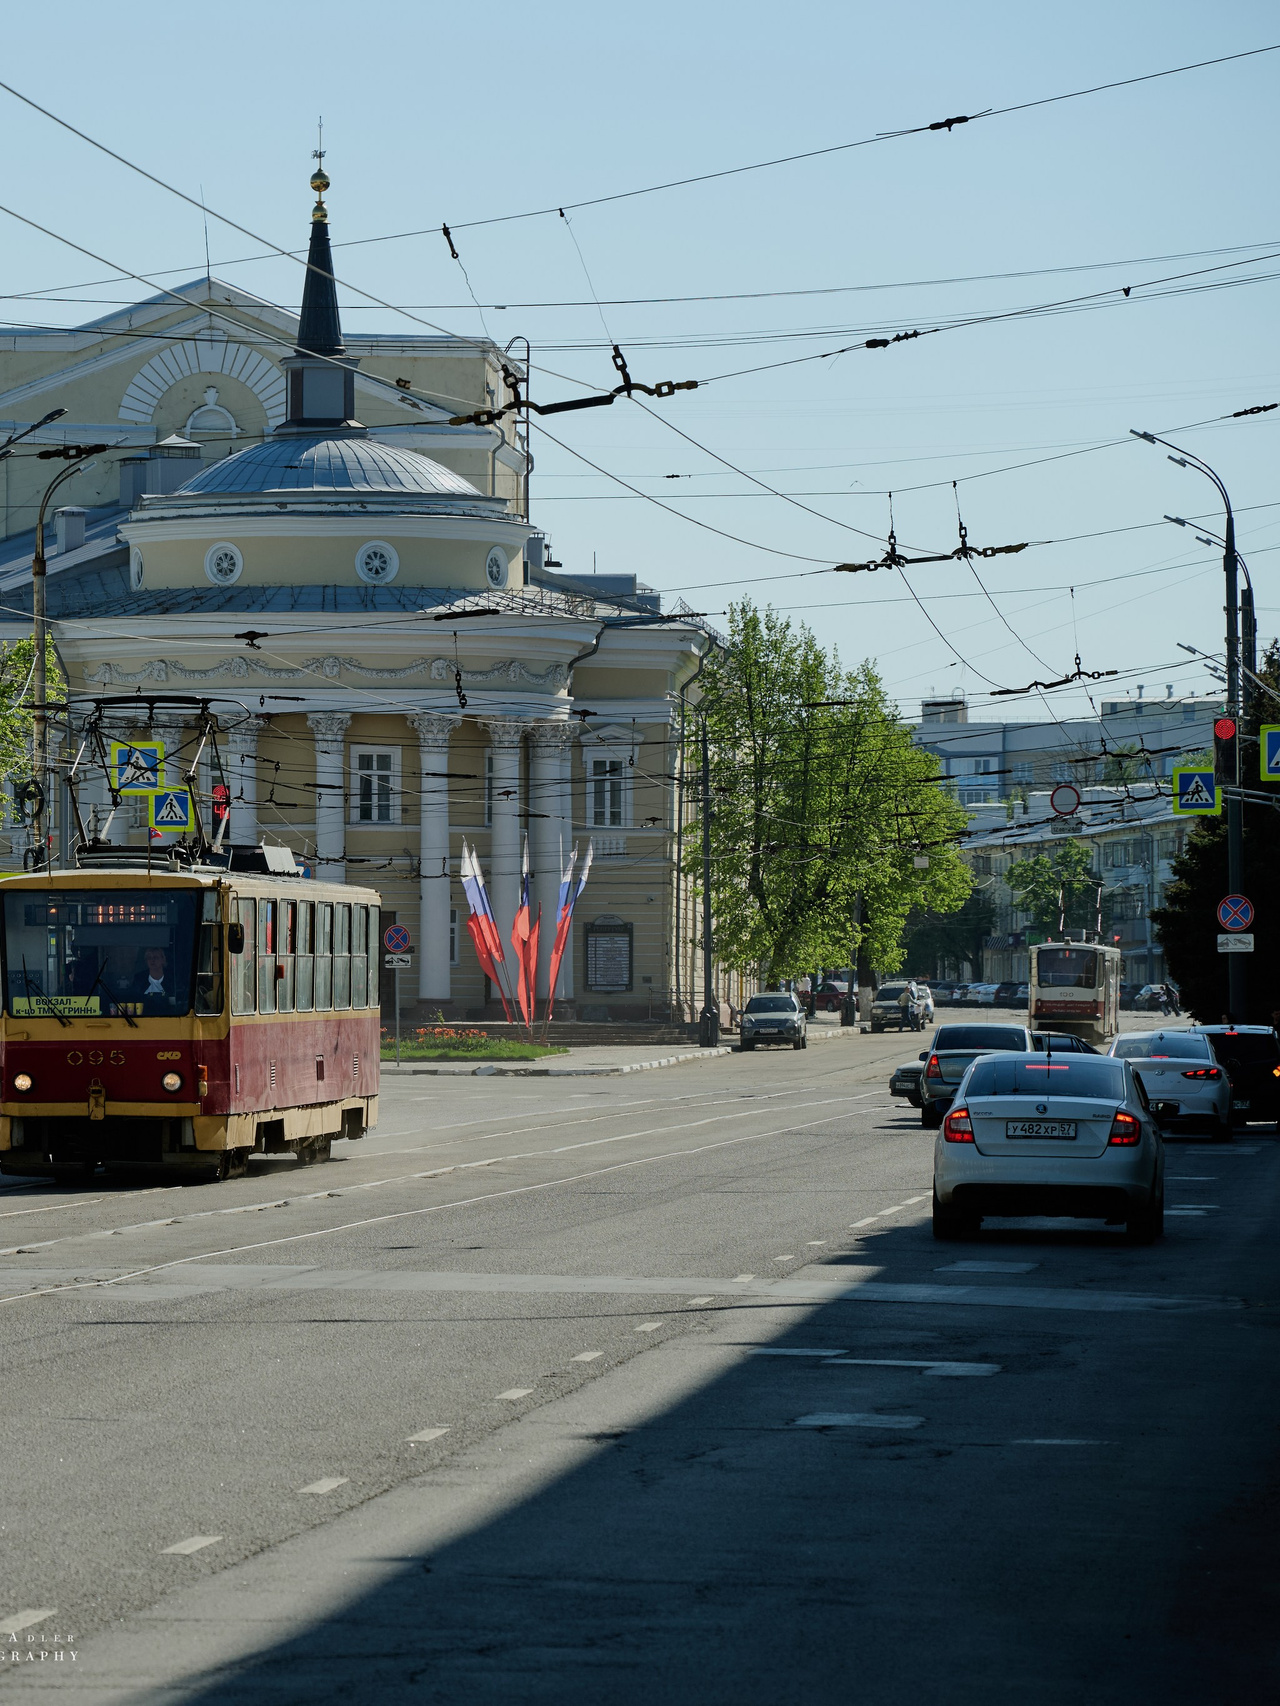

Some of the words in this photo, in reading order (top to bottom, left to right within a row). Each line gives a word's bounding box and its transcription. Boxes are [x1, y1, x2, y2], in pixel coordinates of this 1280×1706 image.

[35, 998, 71, 1006] ВОКЗАЛ
[67, 1050, 126, 1065] 095
[1060, 1123, 1072, 1132] 57
